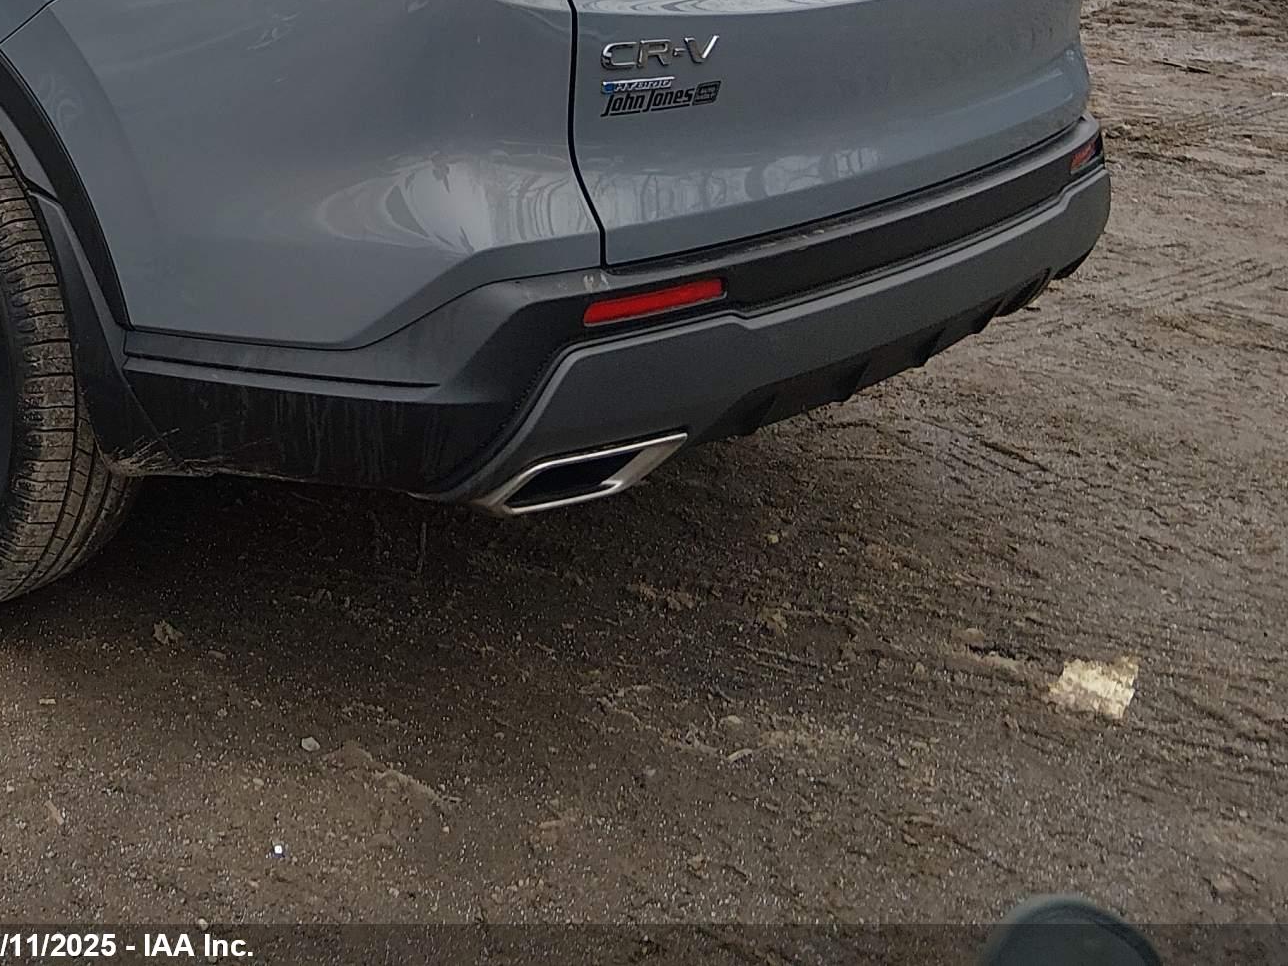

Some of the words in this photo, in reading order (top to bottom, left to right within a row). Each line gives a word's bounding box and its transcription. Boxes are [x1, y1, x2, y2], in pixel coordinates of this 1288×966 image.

[600, 34, 719, 69] CR-V
[600, 93, 645, 117] John
[642, 88, 695, 113] Jones
